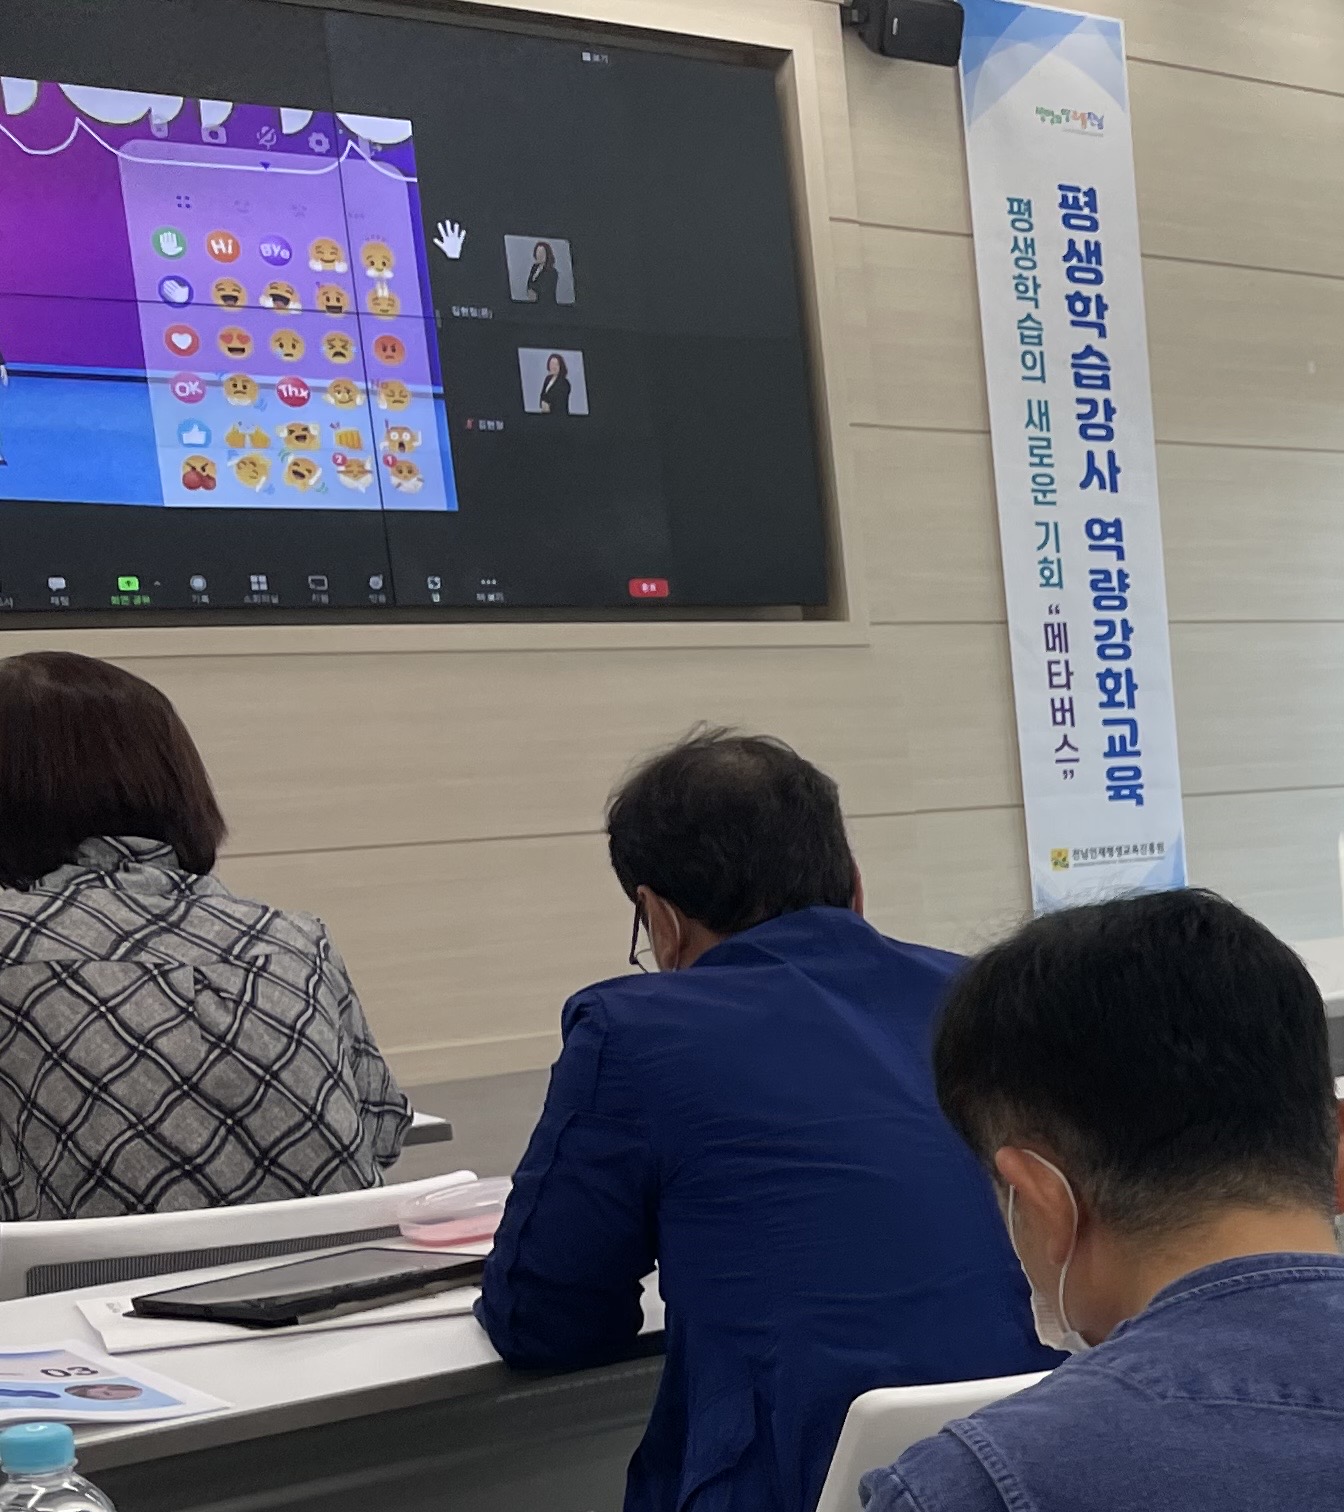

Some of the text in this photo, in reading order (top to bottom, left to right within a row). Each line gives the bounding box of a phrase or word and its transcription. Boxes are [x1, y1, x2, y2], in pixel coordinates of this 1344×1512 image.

[211, 239, 234, 255] Hi
[1006, 196, 1047, 384] 평생학습의
[1057, 183, 1121, 493] 평생학습강사
[174, 380, 203, 396] OK
[278, 383, 309, 400] Thx
[1025, 398, 1058, 506] 새로운
[1035, 521, 1065, 590] 기회
[1084, 516, 1145, 807] 역량강화교육
[40, 1366, 99, 1378] 03
